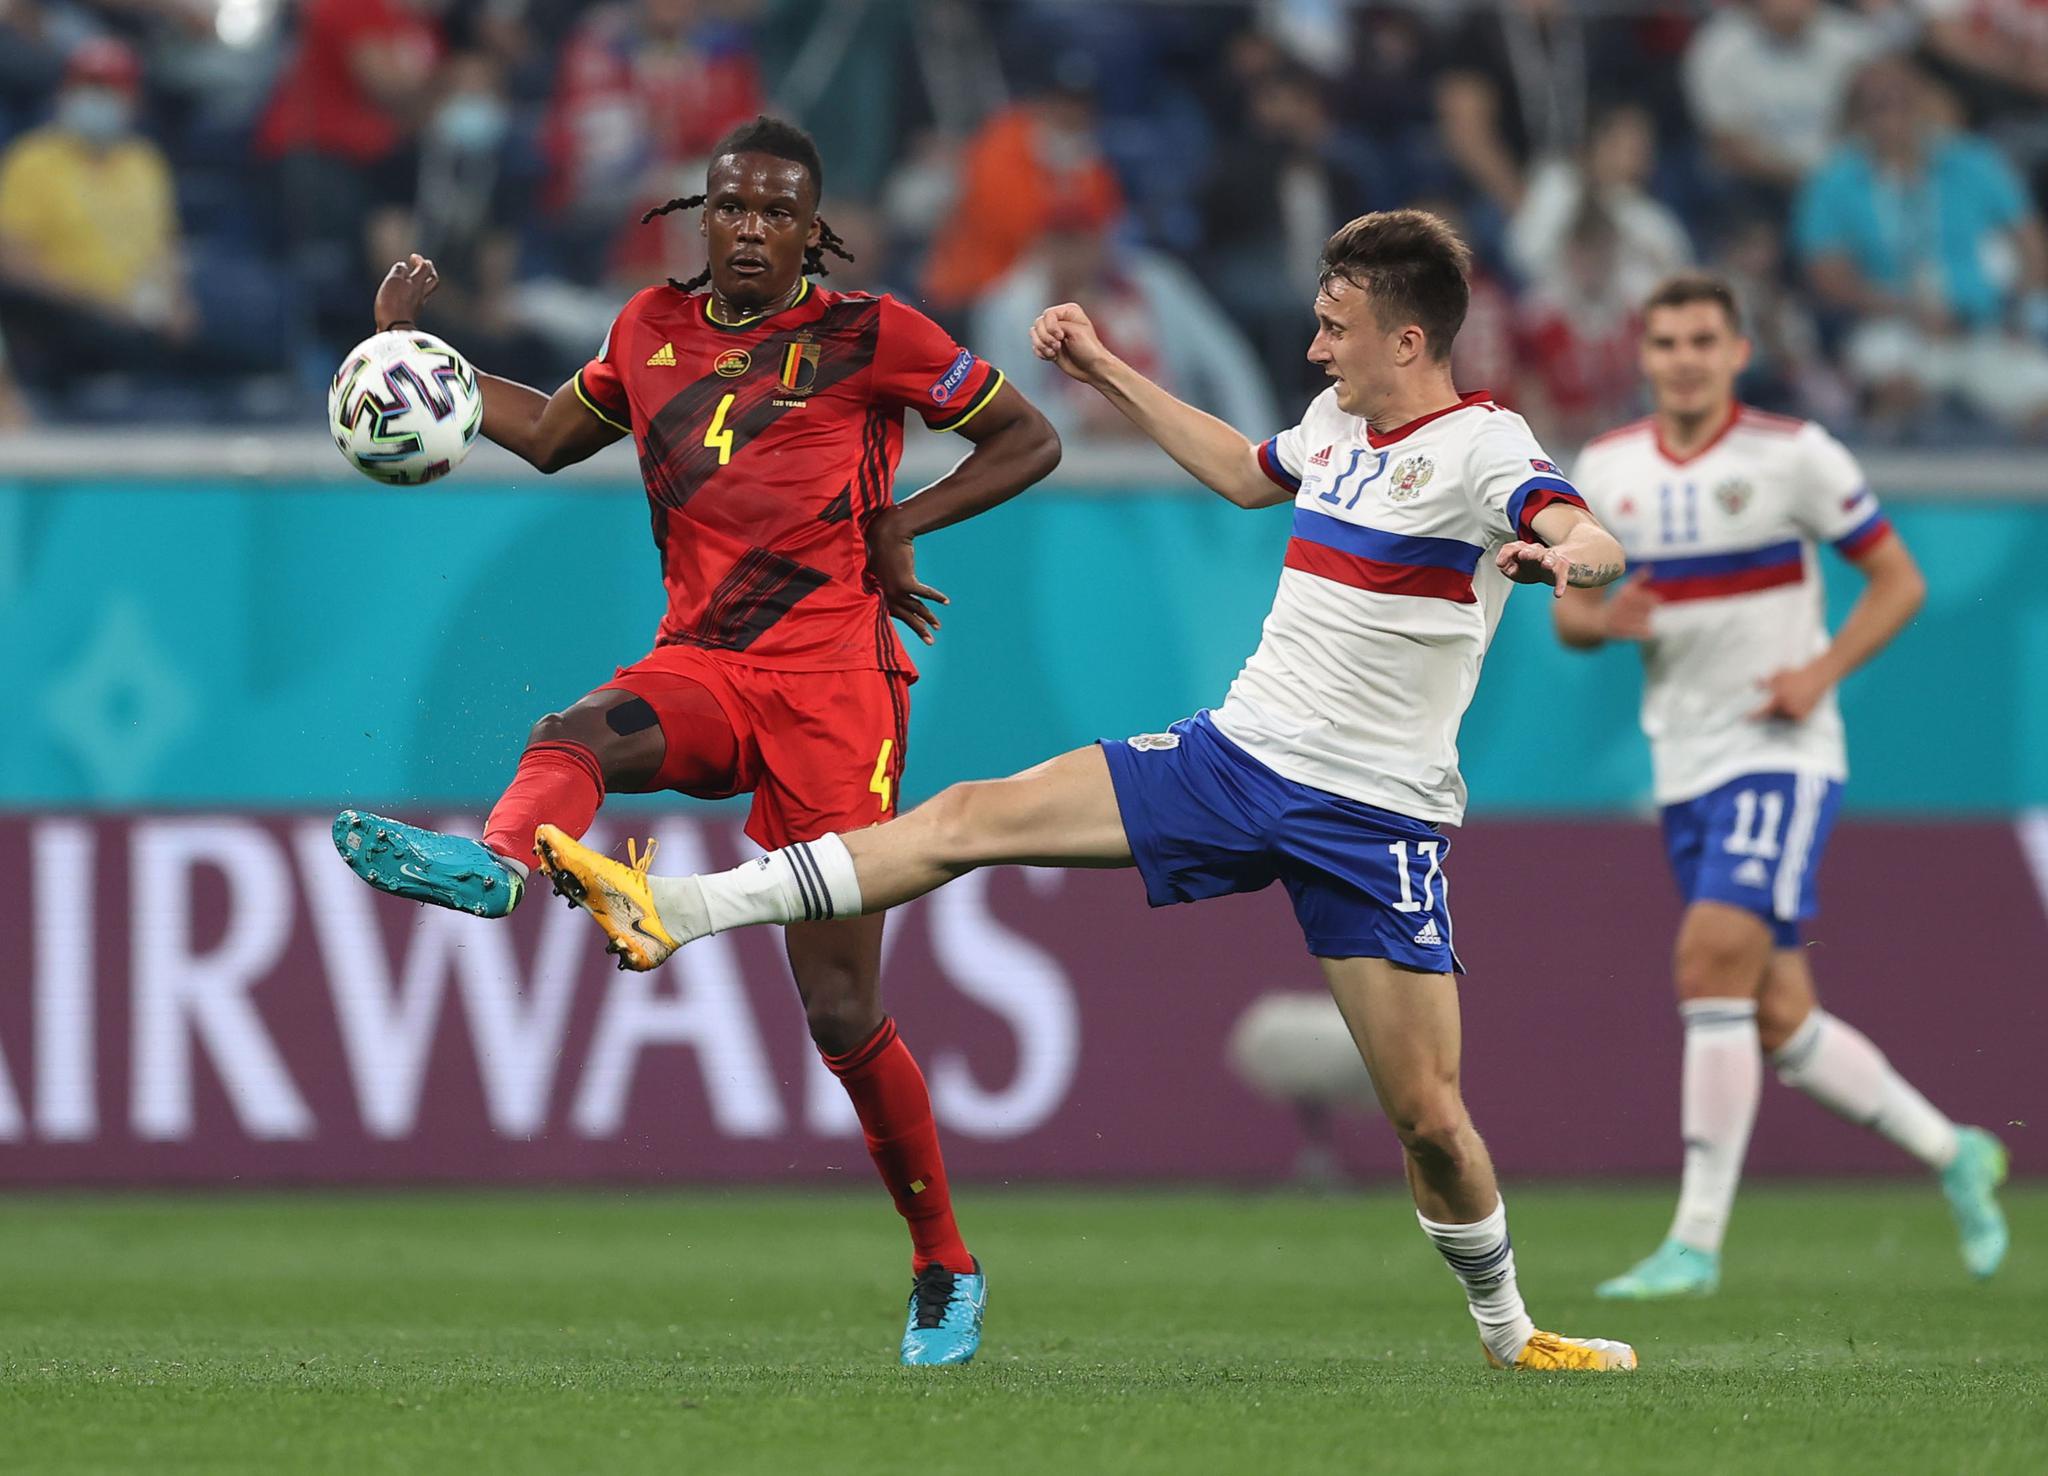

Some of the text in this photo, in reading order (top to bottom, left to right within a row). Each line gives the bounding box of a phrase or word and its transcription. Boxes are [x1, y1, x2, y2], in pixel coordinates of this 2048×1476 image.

[703, 394, 735, 465] 4
[1319, 449, 1389, 510] 17
[869, 739, 894, 812] 4
[1723, 789, 1783, 859] 11
[1389, 841, 1439, 912] 17
[0, 816, 1080, 1142] IRWAS
